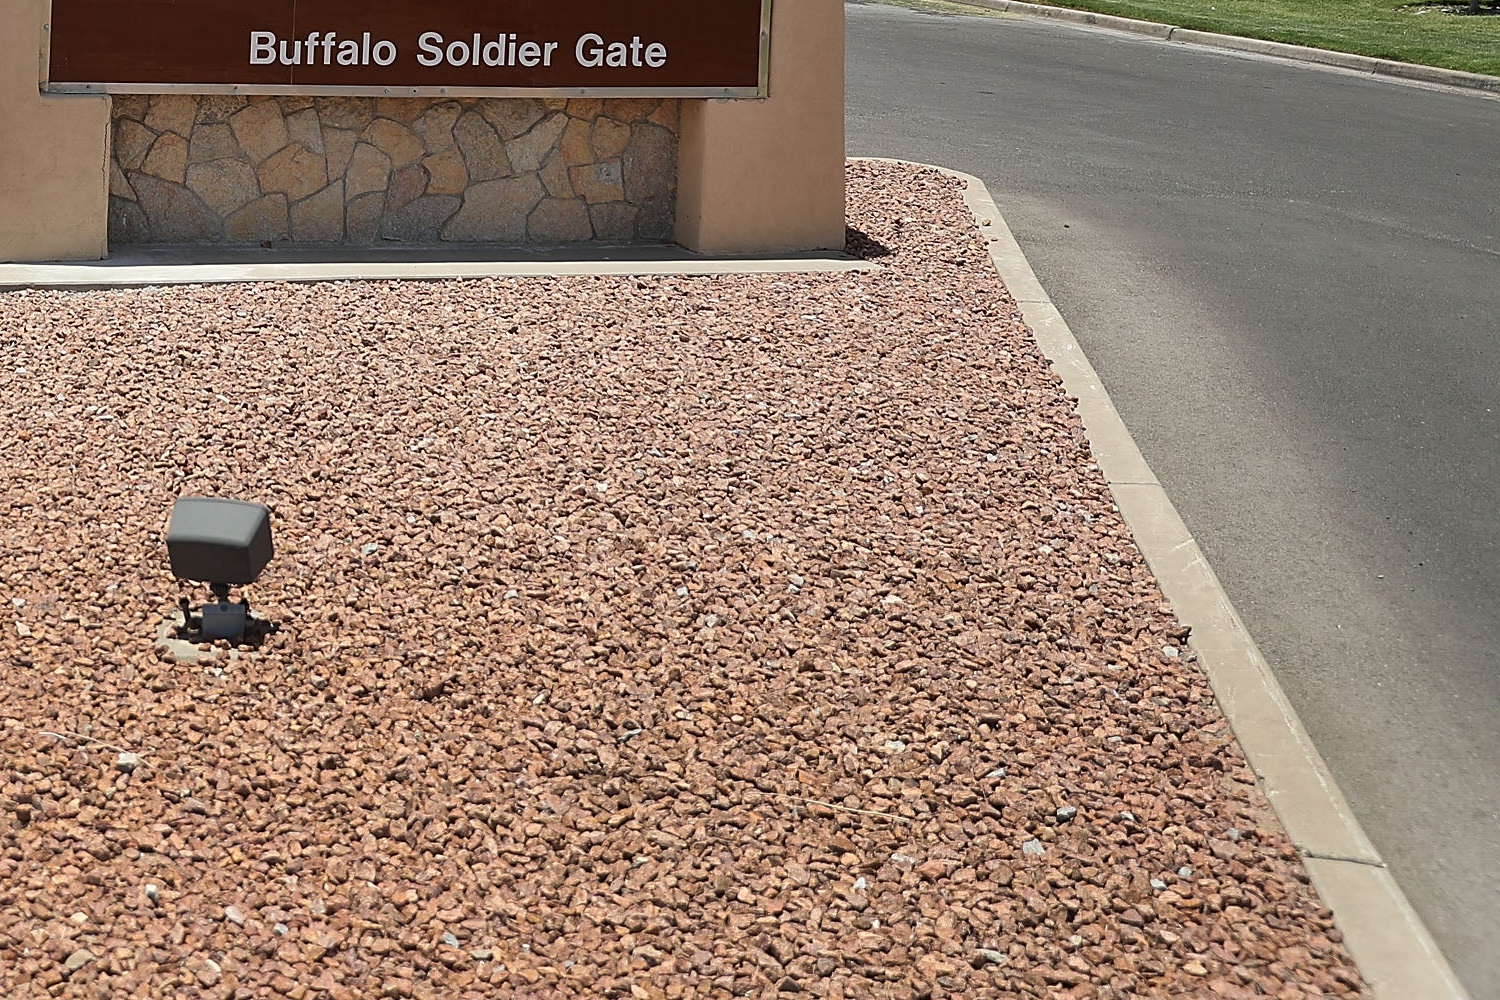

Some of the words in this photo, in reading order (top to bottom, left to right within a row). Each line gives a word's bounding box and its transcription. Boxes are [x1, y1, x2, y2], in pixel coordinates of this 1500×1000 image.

[249, 31, 397, 66] Buffalo
[416, 32, 558, 68] Soldier
[575, 33, 668, 68] Gate
